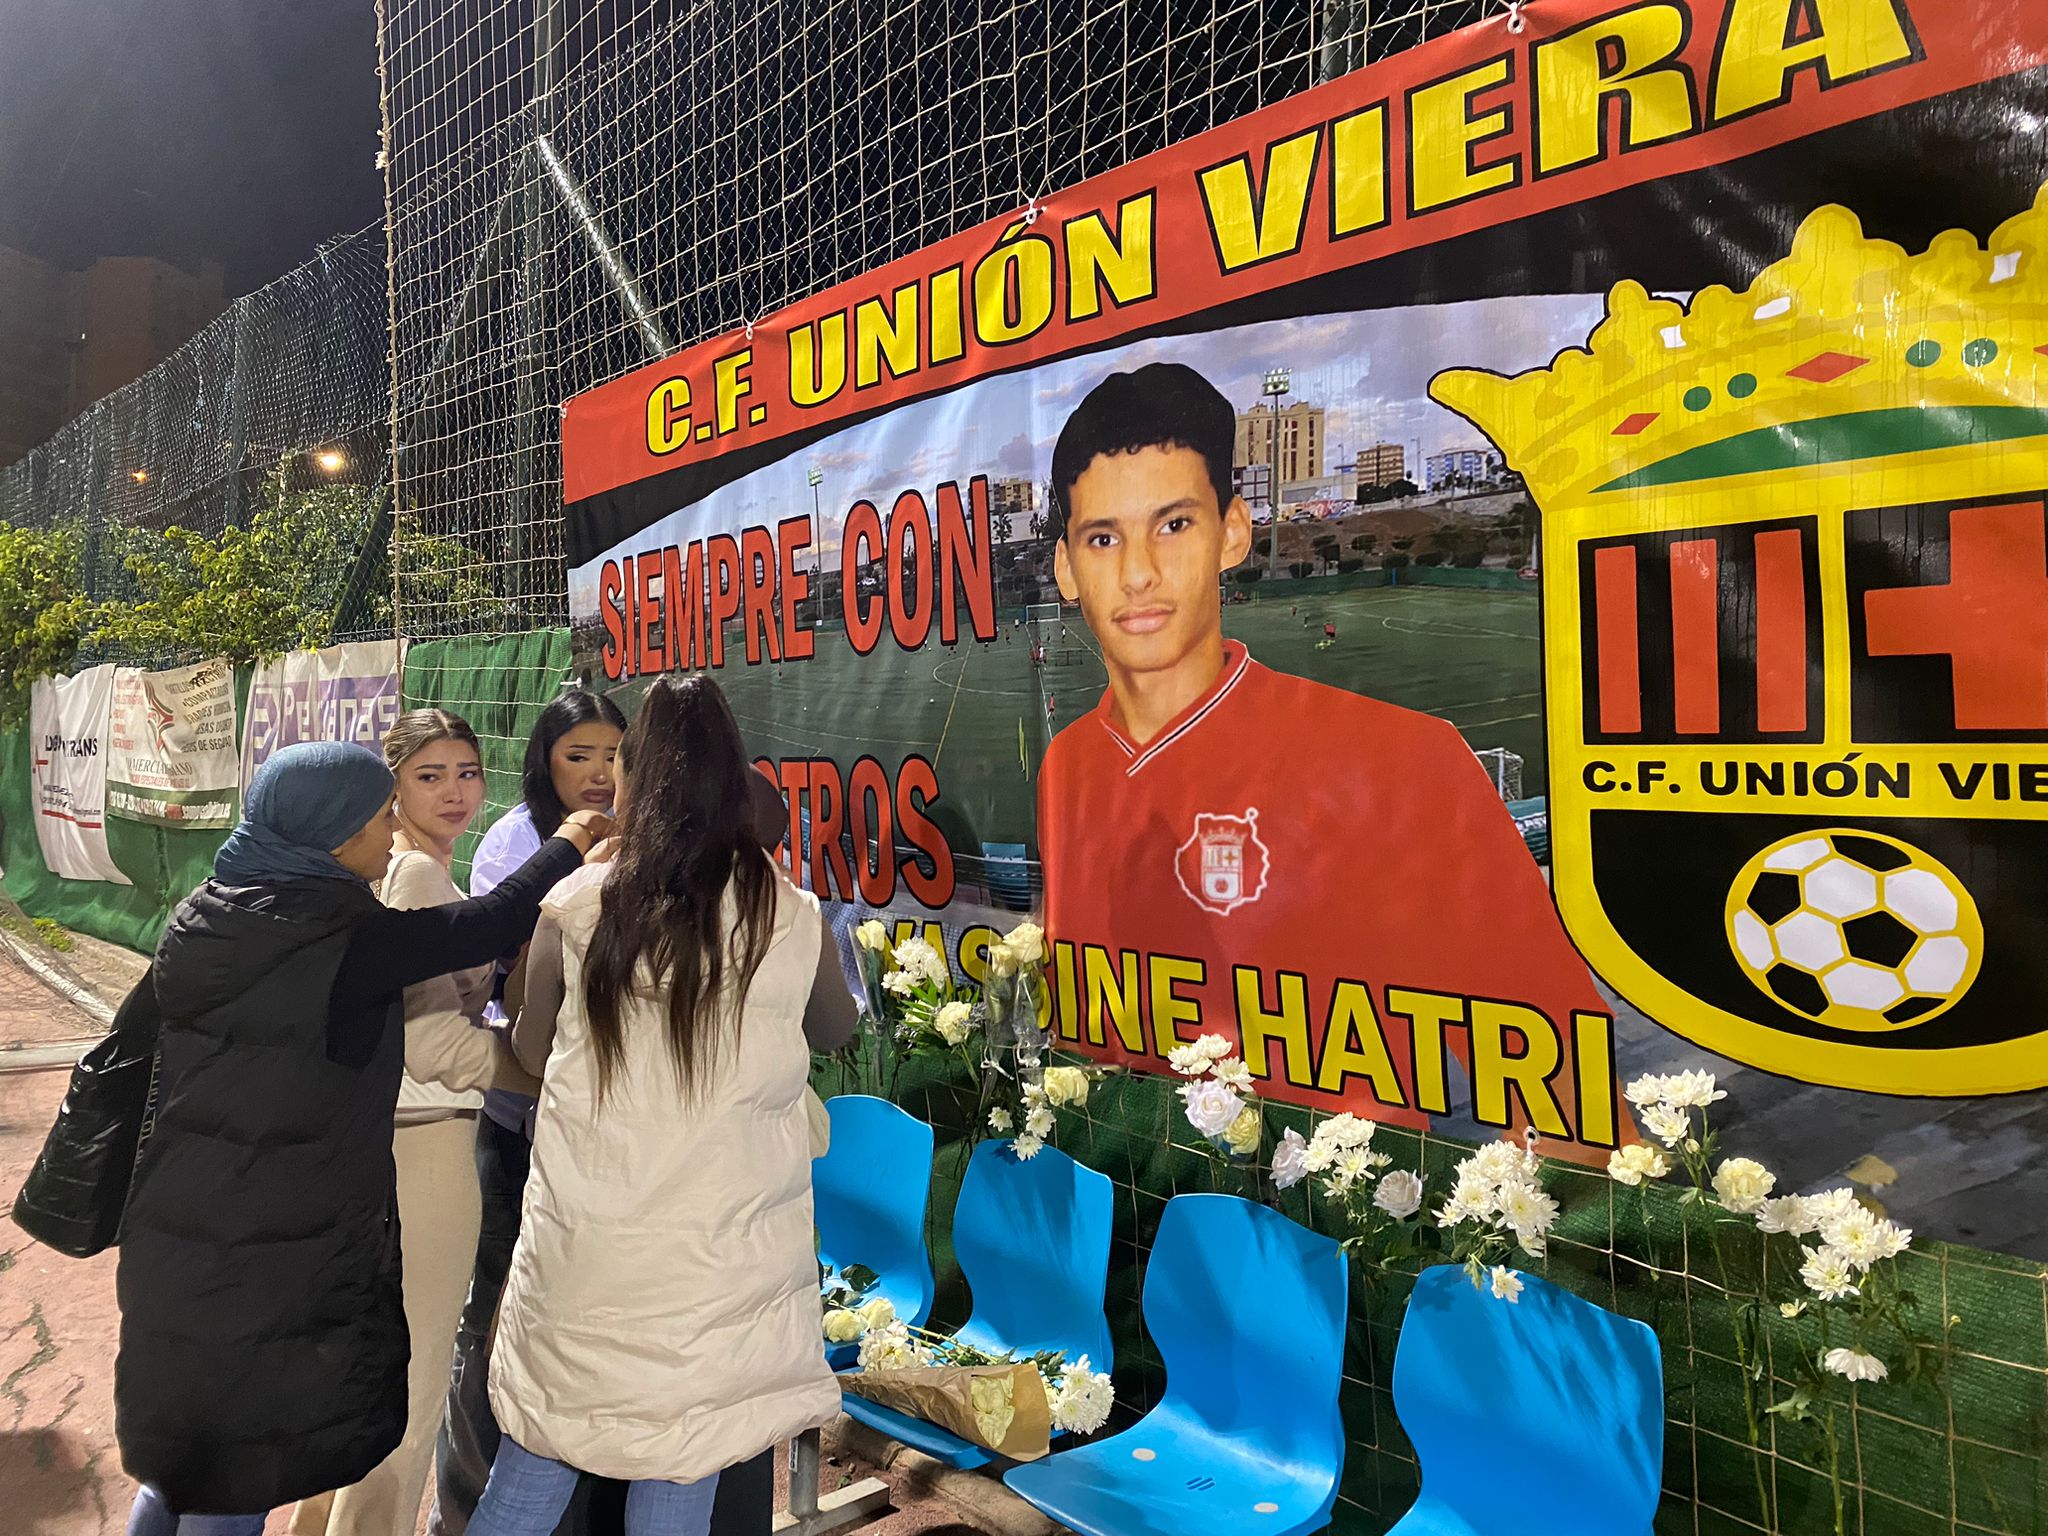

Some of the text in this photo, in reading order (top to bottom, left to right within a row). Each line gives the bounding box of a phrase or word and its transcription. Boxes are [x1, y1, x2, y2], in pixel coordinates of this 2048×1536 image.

[646, 0, 1928, 456] C.F. UNIÓN VIERA
[600, 474, 997, 681] SIEMPRE CON
[1582, 752, 2048, 802] C.F. UNIÓN VIE
[1232, 964, 1620, 1150] HATRI
